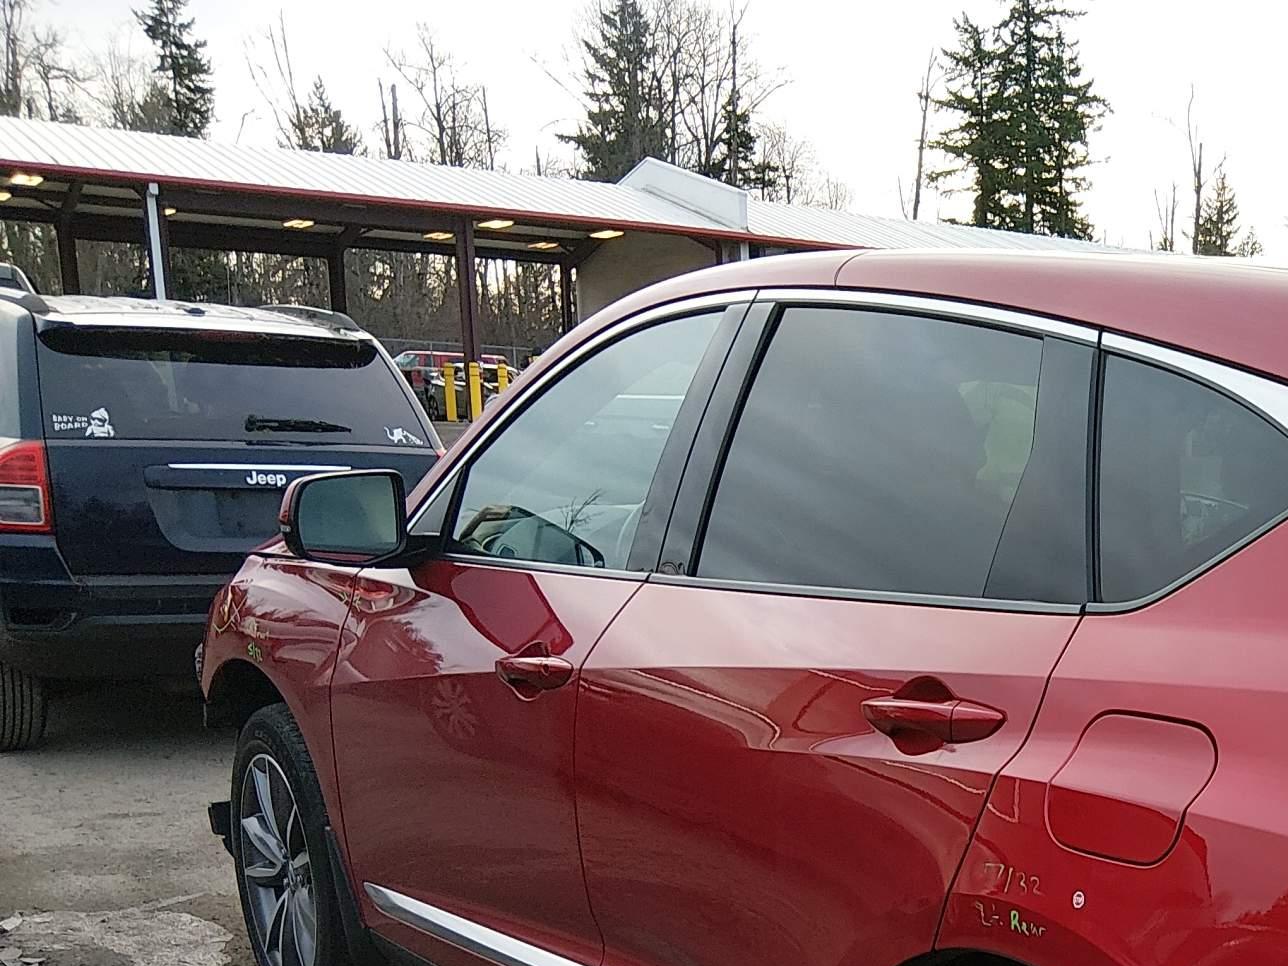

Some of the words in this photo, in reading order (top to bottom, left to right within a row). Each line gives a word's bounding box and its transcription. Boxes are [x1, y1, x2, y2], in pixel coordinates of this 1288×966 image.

[52, 414, 74, 422] BABY
[54, 421, 88, 431] BOARD
[246, 470, 287, 487] Jeep
[984, 862, 1046, 896] 7/32
[1010, 910, 1046, 936] Rear
